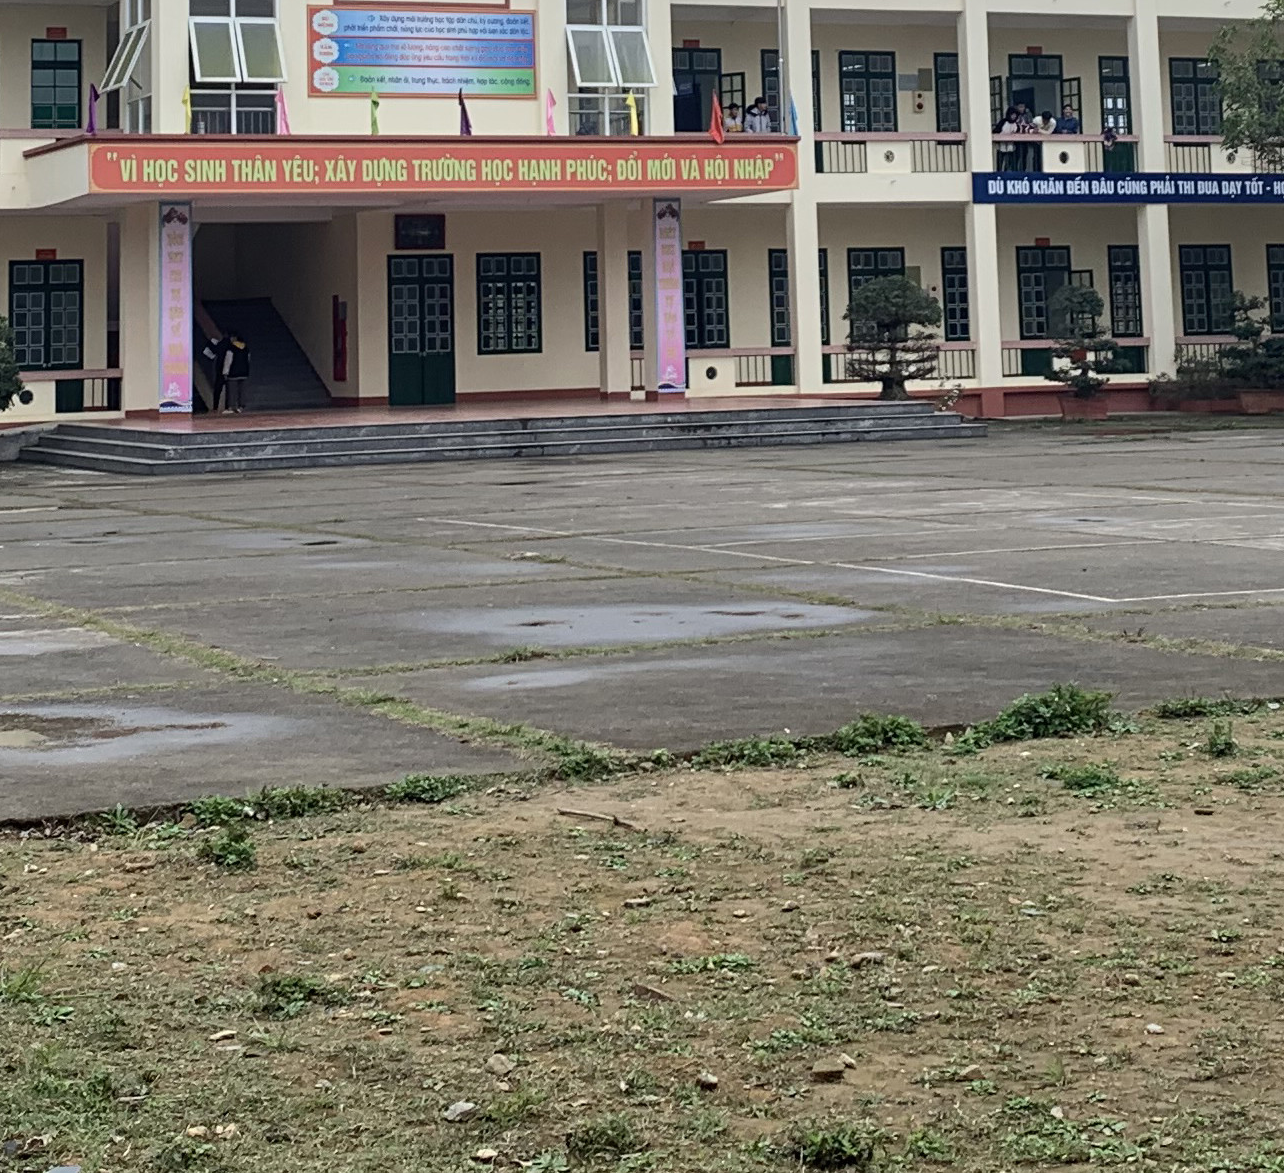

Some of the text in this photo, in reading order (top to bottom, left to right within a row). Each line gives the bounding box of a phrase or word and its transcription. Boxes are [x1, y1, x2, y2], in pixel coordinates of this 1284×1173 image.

[142, 159, 179, 187] HỌC
[184, 159, 227, 183] SINH
[231, 154, 277, 183] THÂN
[282, 154, 320, 185] YÊU;
[324, 154, 357, 182] XÂY
[361, 157, 408, 187] DỰNG
[412, 153, 477, 182] TRƯỜNG
[481, 159, 513, 186] HỌC
[518, 158, 562, 186] HẠNH
[566, 154, 613, 183] PHÚC;
[616, 150, 642, 181] ĐỔI
[646, 152, 676, 181] MỚI
[680, 154, 701, 180] VÀ
[704, 154, 730, 184] HỘI
[987, 176, 1004, 195] DÙ
[1006, 176, 1030, 195] KHÓ
[1032, 177, 1064, 195] KHĂN
[1066, 176, 1089, 195] ĐẾN
[1091, 177, 1114, 195] ĐÂU
[1117, 176, 1148, 195] CŨNG
[1150, 175, 1175, 195] PHẢI
[1177, 180, 1195, 195] THI
[1197, 180, 1220, 195] ĐUA
[1221, 180, 1243, 198] DẠY
[1244, 177, 1264, 195] TỐT
